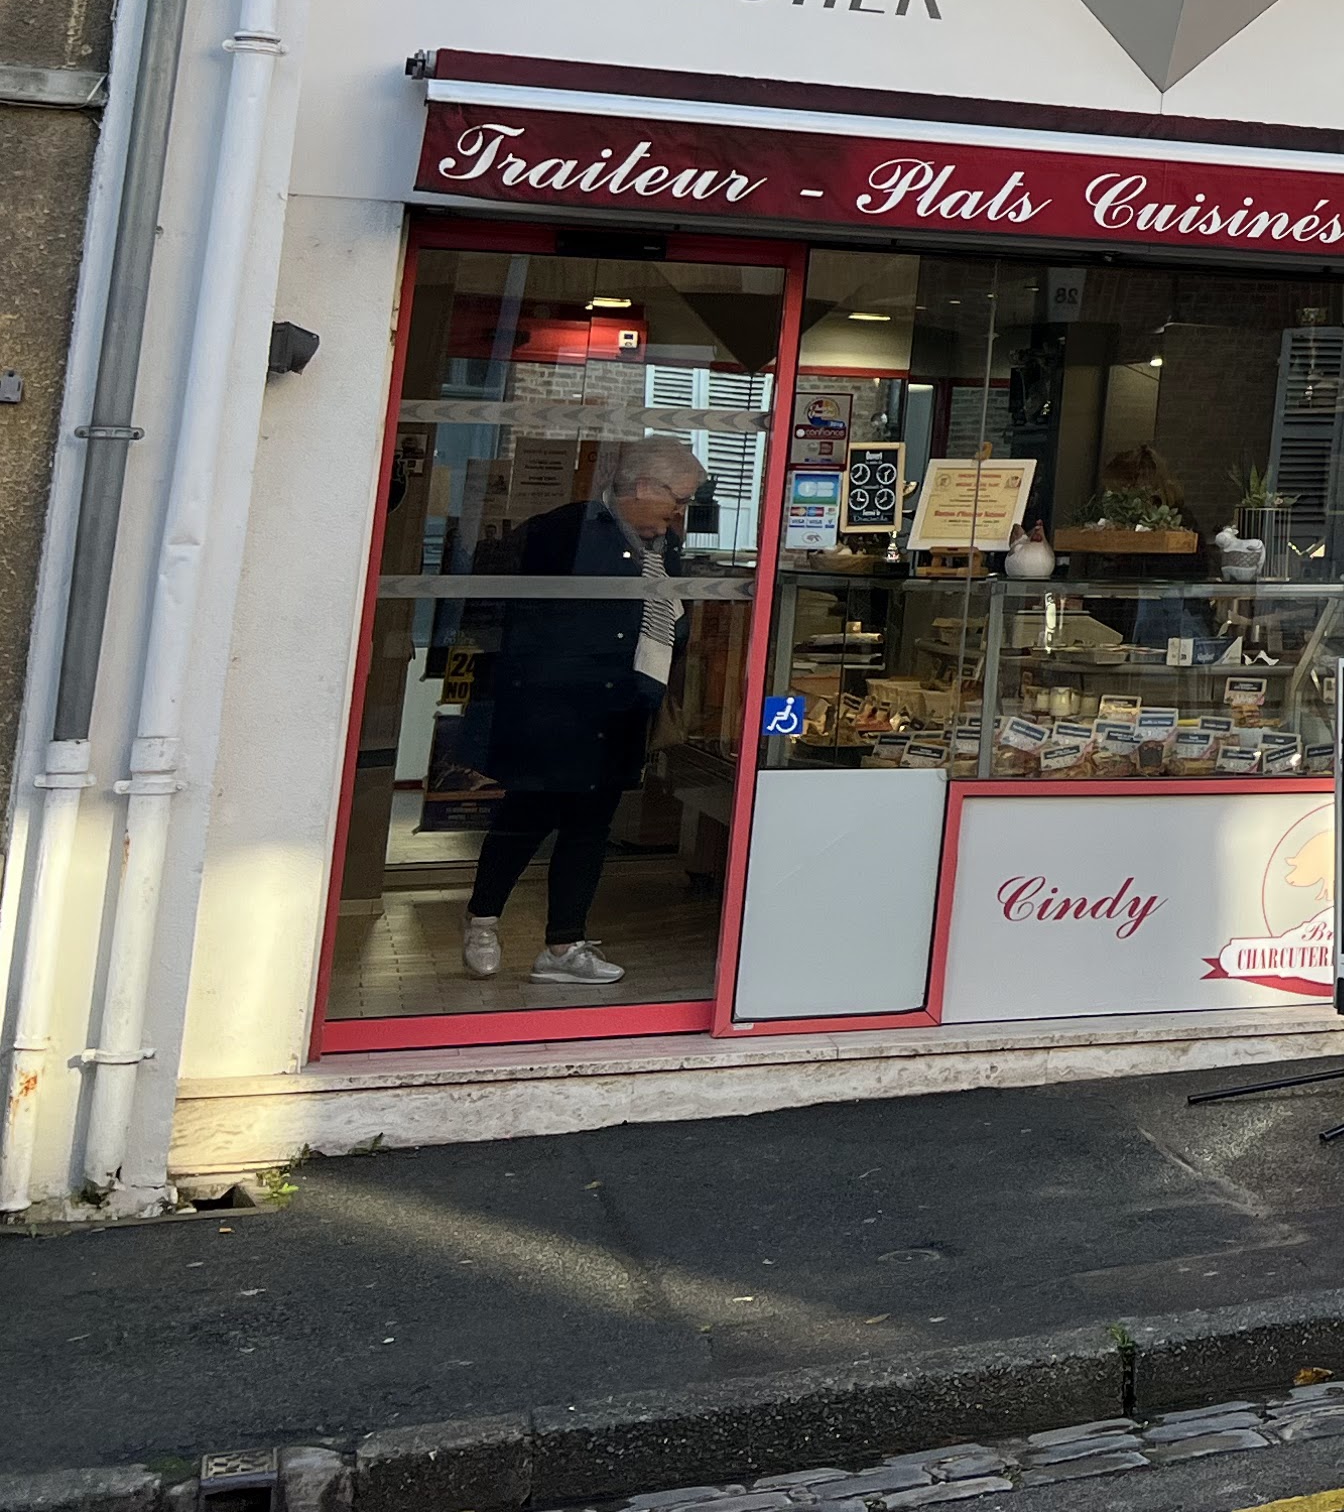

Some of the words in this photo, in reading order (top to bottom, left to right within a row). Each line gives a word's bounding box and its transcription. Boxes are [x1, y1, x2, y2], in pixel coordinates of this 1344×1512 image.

[438, 123, 768, 204] Traiteur
[856, 158, 1053, 224] Plats
[997, 875, 1168, 940] Cindy
